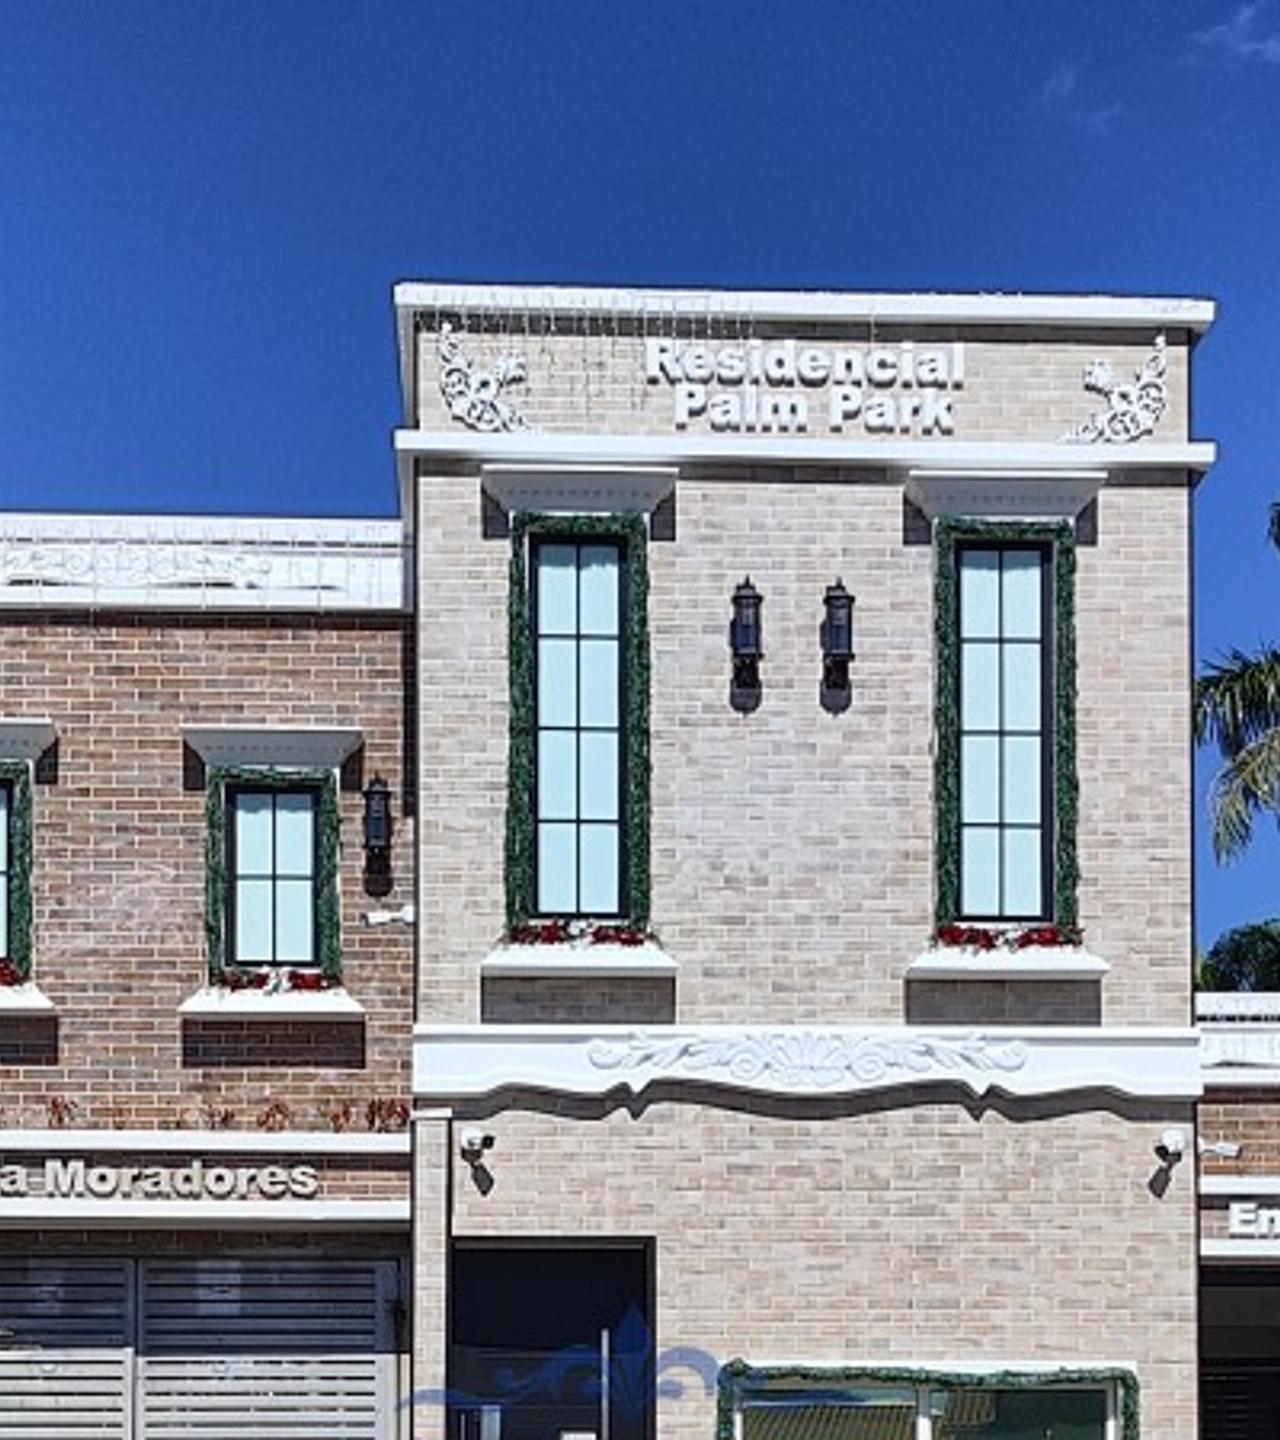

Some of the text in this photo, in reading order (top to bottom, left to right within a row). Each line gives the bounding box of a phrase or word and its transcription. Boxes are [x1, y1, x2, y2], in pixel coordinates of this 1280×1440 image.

[645, 338, 966, 388] Residencial
[675, 383, 957, 435] Palm Park
[43, 1159, 319, 1198] Moradores
